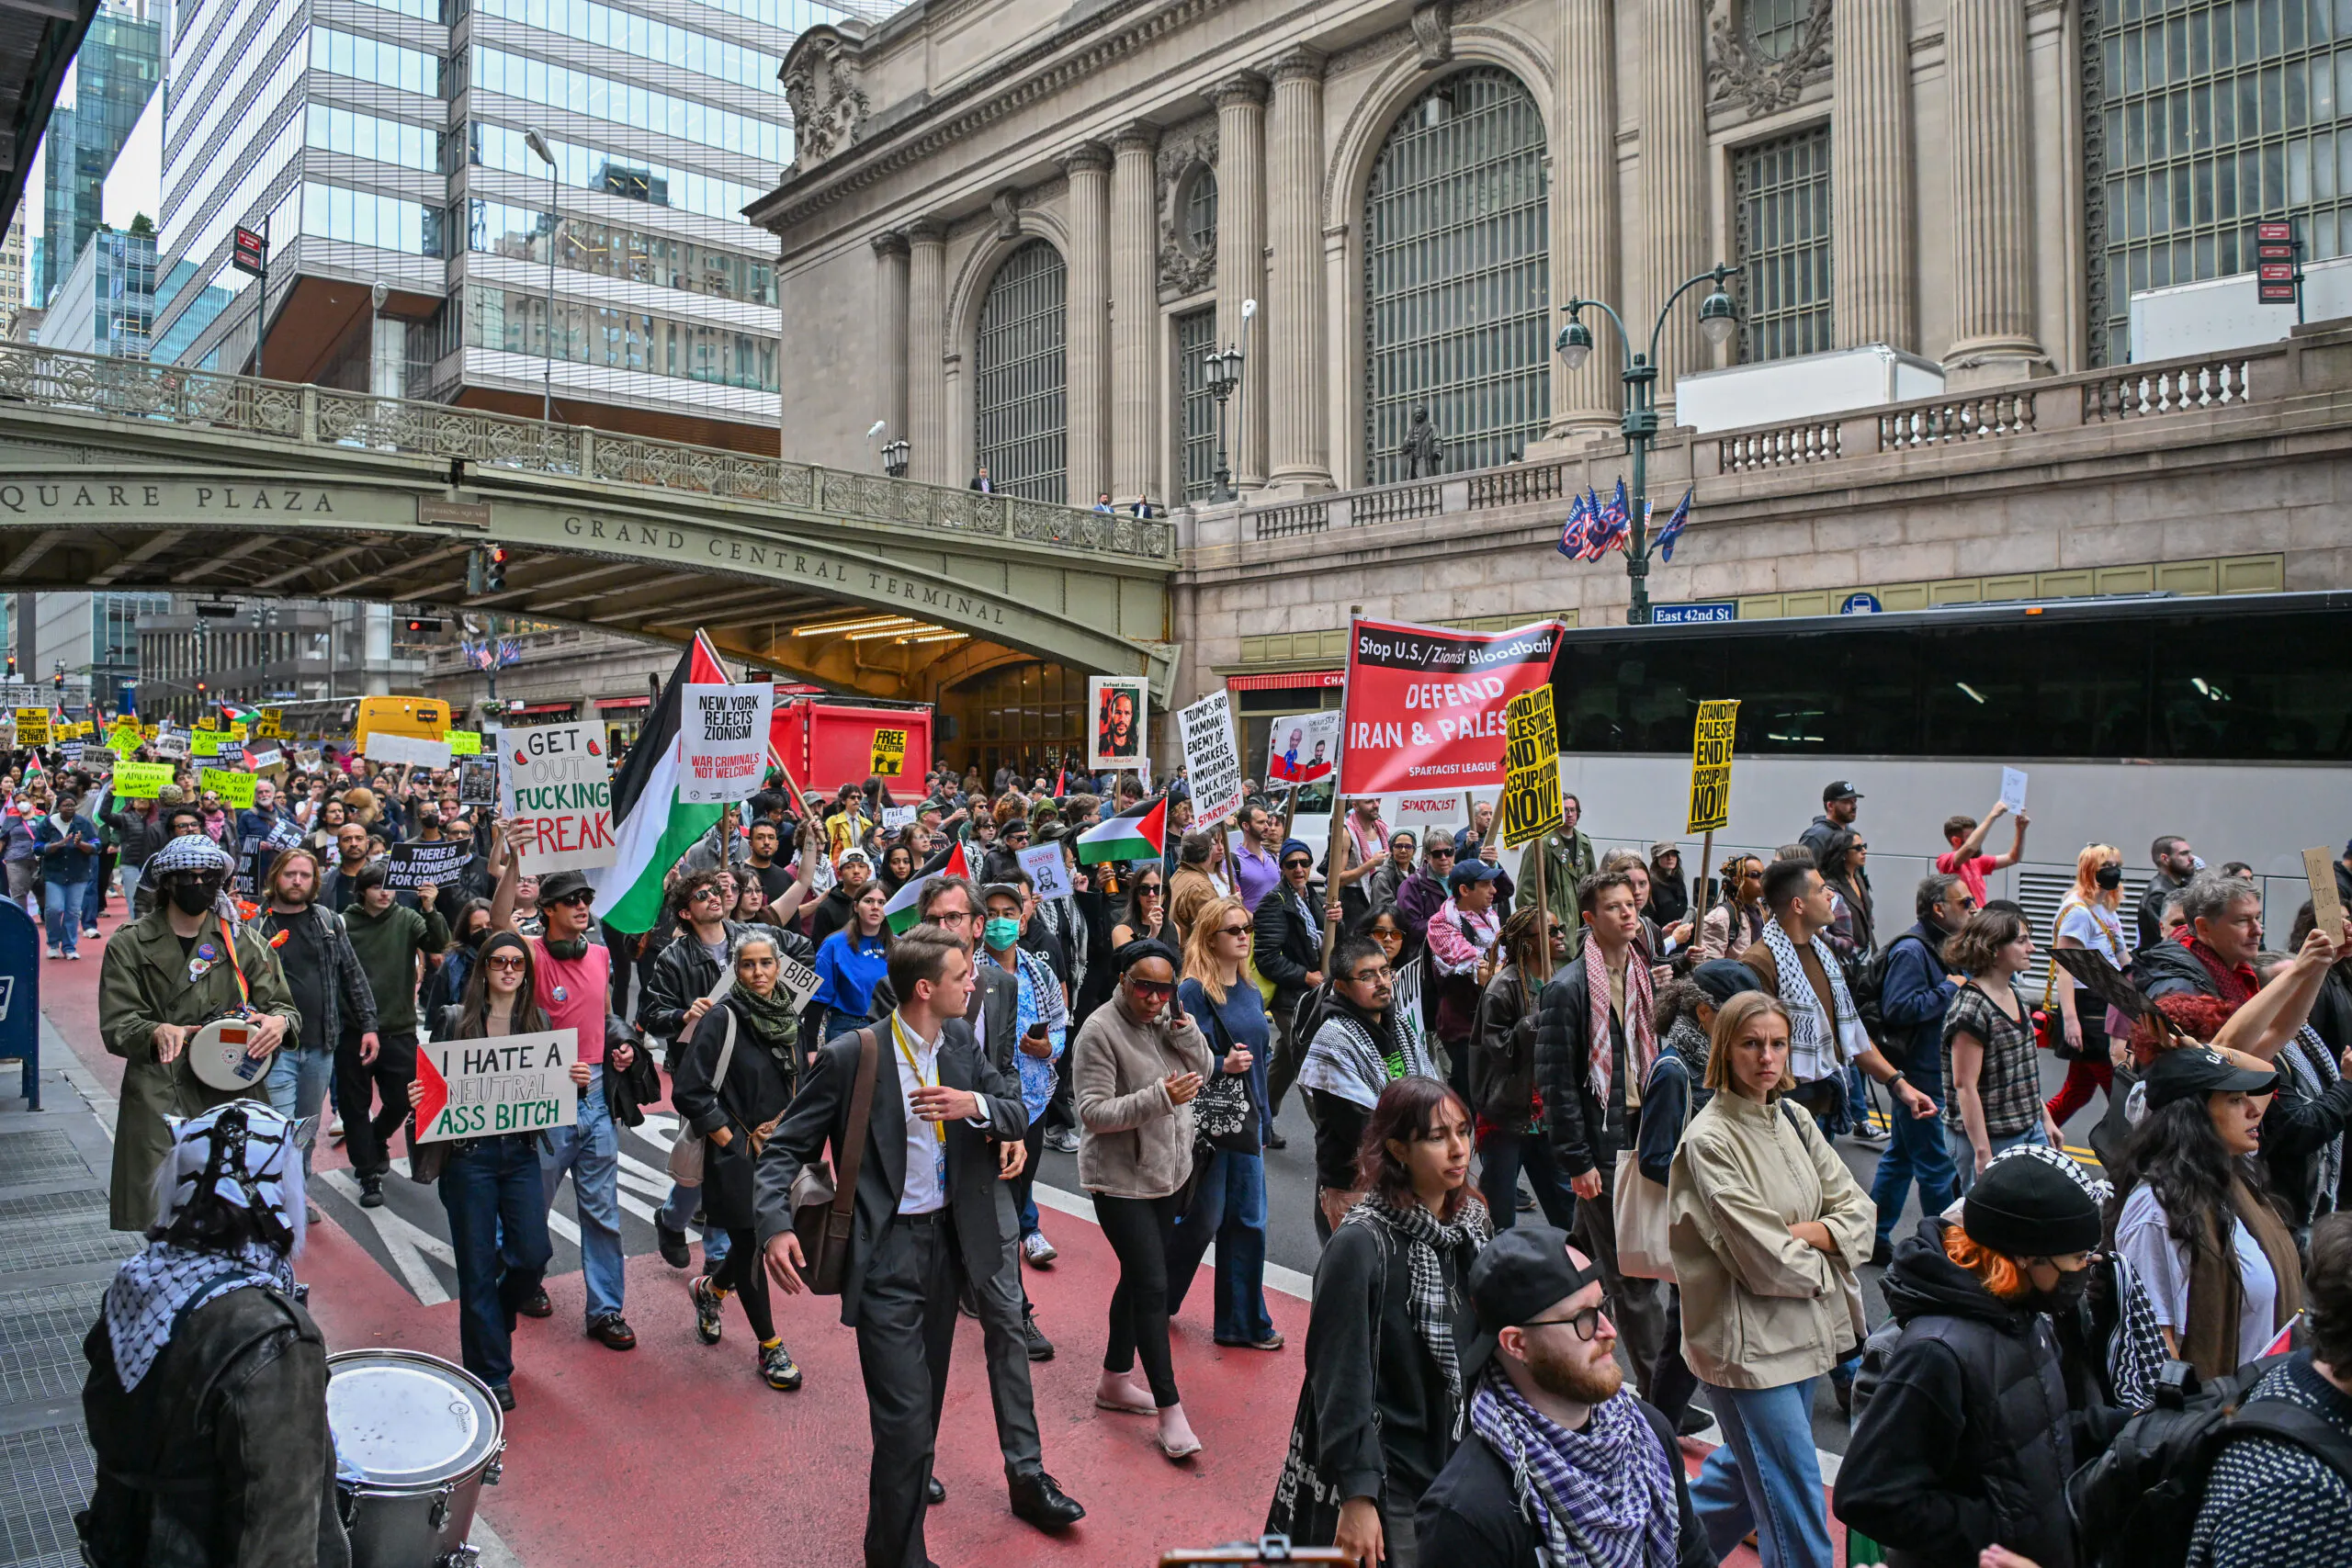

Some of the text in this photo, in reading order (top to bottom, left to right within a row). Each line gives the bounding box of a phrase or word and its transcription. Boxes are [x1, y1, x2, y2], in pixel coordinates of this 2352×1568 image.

[197, 487, 334, 513] PLAZA
[565, 516, 1004, 626] GRAND CENTRAL TERMINAL
[1657, 608, 1729, 622] East 42nd St
[1359, 636, 1391, 662] Stop
[699, 695, 759, 710] NEW YORK
[1405, 676, 1506, 709] DEFEND
[1533, 688, 1551, 712] WITH
[705, 711, 753, 726] REJECTS
[1184, 695, 1227, 724] TRUMP'S BRO
[1700, 704, 1726, 720] STAND
[705, 726, 752, 740] ZIONISM
[876, 730, 904, 745] FREE
[1189, 713, 1227, 738] MAMDANI:
[1351, 721, 1404, 750] IRAN
[1411, 721, 1435, 747] &
[1508, 707, 1555, 742] ALESTINE!
[528, 728, 580, 756] GET
[873, 744, 904, 753] PALESTINE
[1187, 728, 1225, 756] ENEMY OF
[1194, 742, 1229, 768] WORKERS
[1540, 727, 1556, 761] THE
[1697, 739, 1723, 766] END
[532, 756, 585, 783] OUT
[692, 752, 760, 768] WAR CRIMINALS
[695, 764, 756, 779] NOT WELCOME
[1192, 754, 1235, 784] IMMIGRANTS
[1408, 761, 1497, 777] SPARTACIST LEAGUE
[204, 769, 221, 780] NO
[1195, 766, 1240, 798] BLACK PEOPLE
[514, 782, 611, 812] FUCKING
[1401, 798, 1456, 813] SPARTACIST
[1506, 778, 1559, 835] NOW!
[887, 809, 903, 818] FREE
[1198, 794, 1240, 828] SPARTACIST
[517, 810, 616, 856] FREAK
[390, 854, 467, 874] NO ATONEMENT
[413, 845, 458, 860] THERE IS
[1029, 853, 1055, 864] WANTED
[388, 868, 461, 886] FOR GENOCIDE
[784, 961, 819, 993] BIBI
[443, 1043, 562, 1077] I HATE A
[447, 1073, 553, 1106] NEUTRAL
[436, 1099, 560, 1135] ASS BITCH
